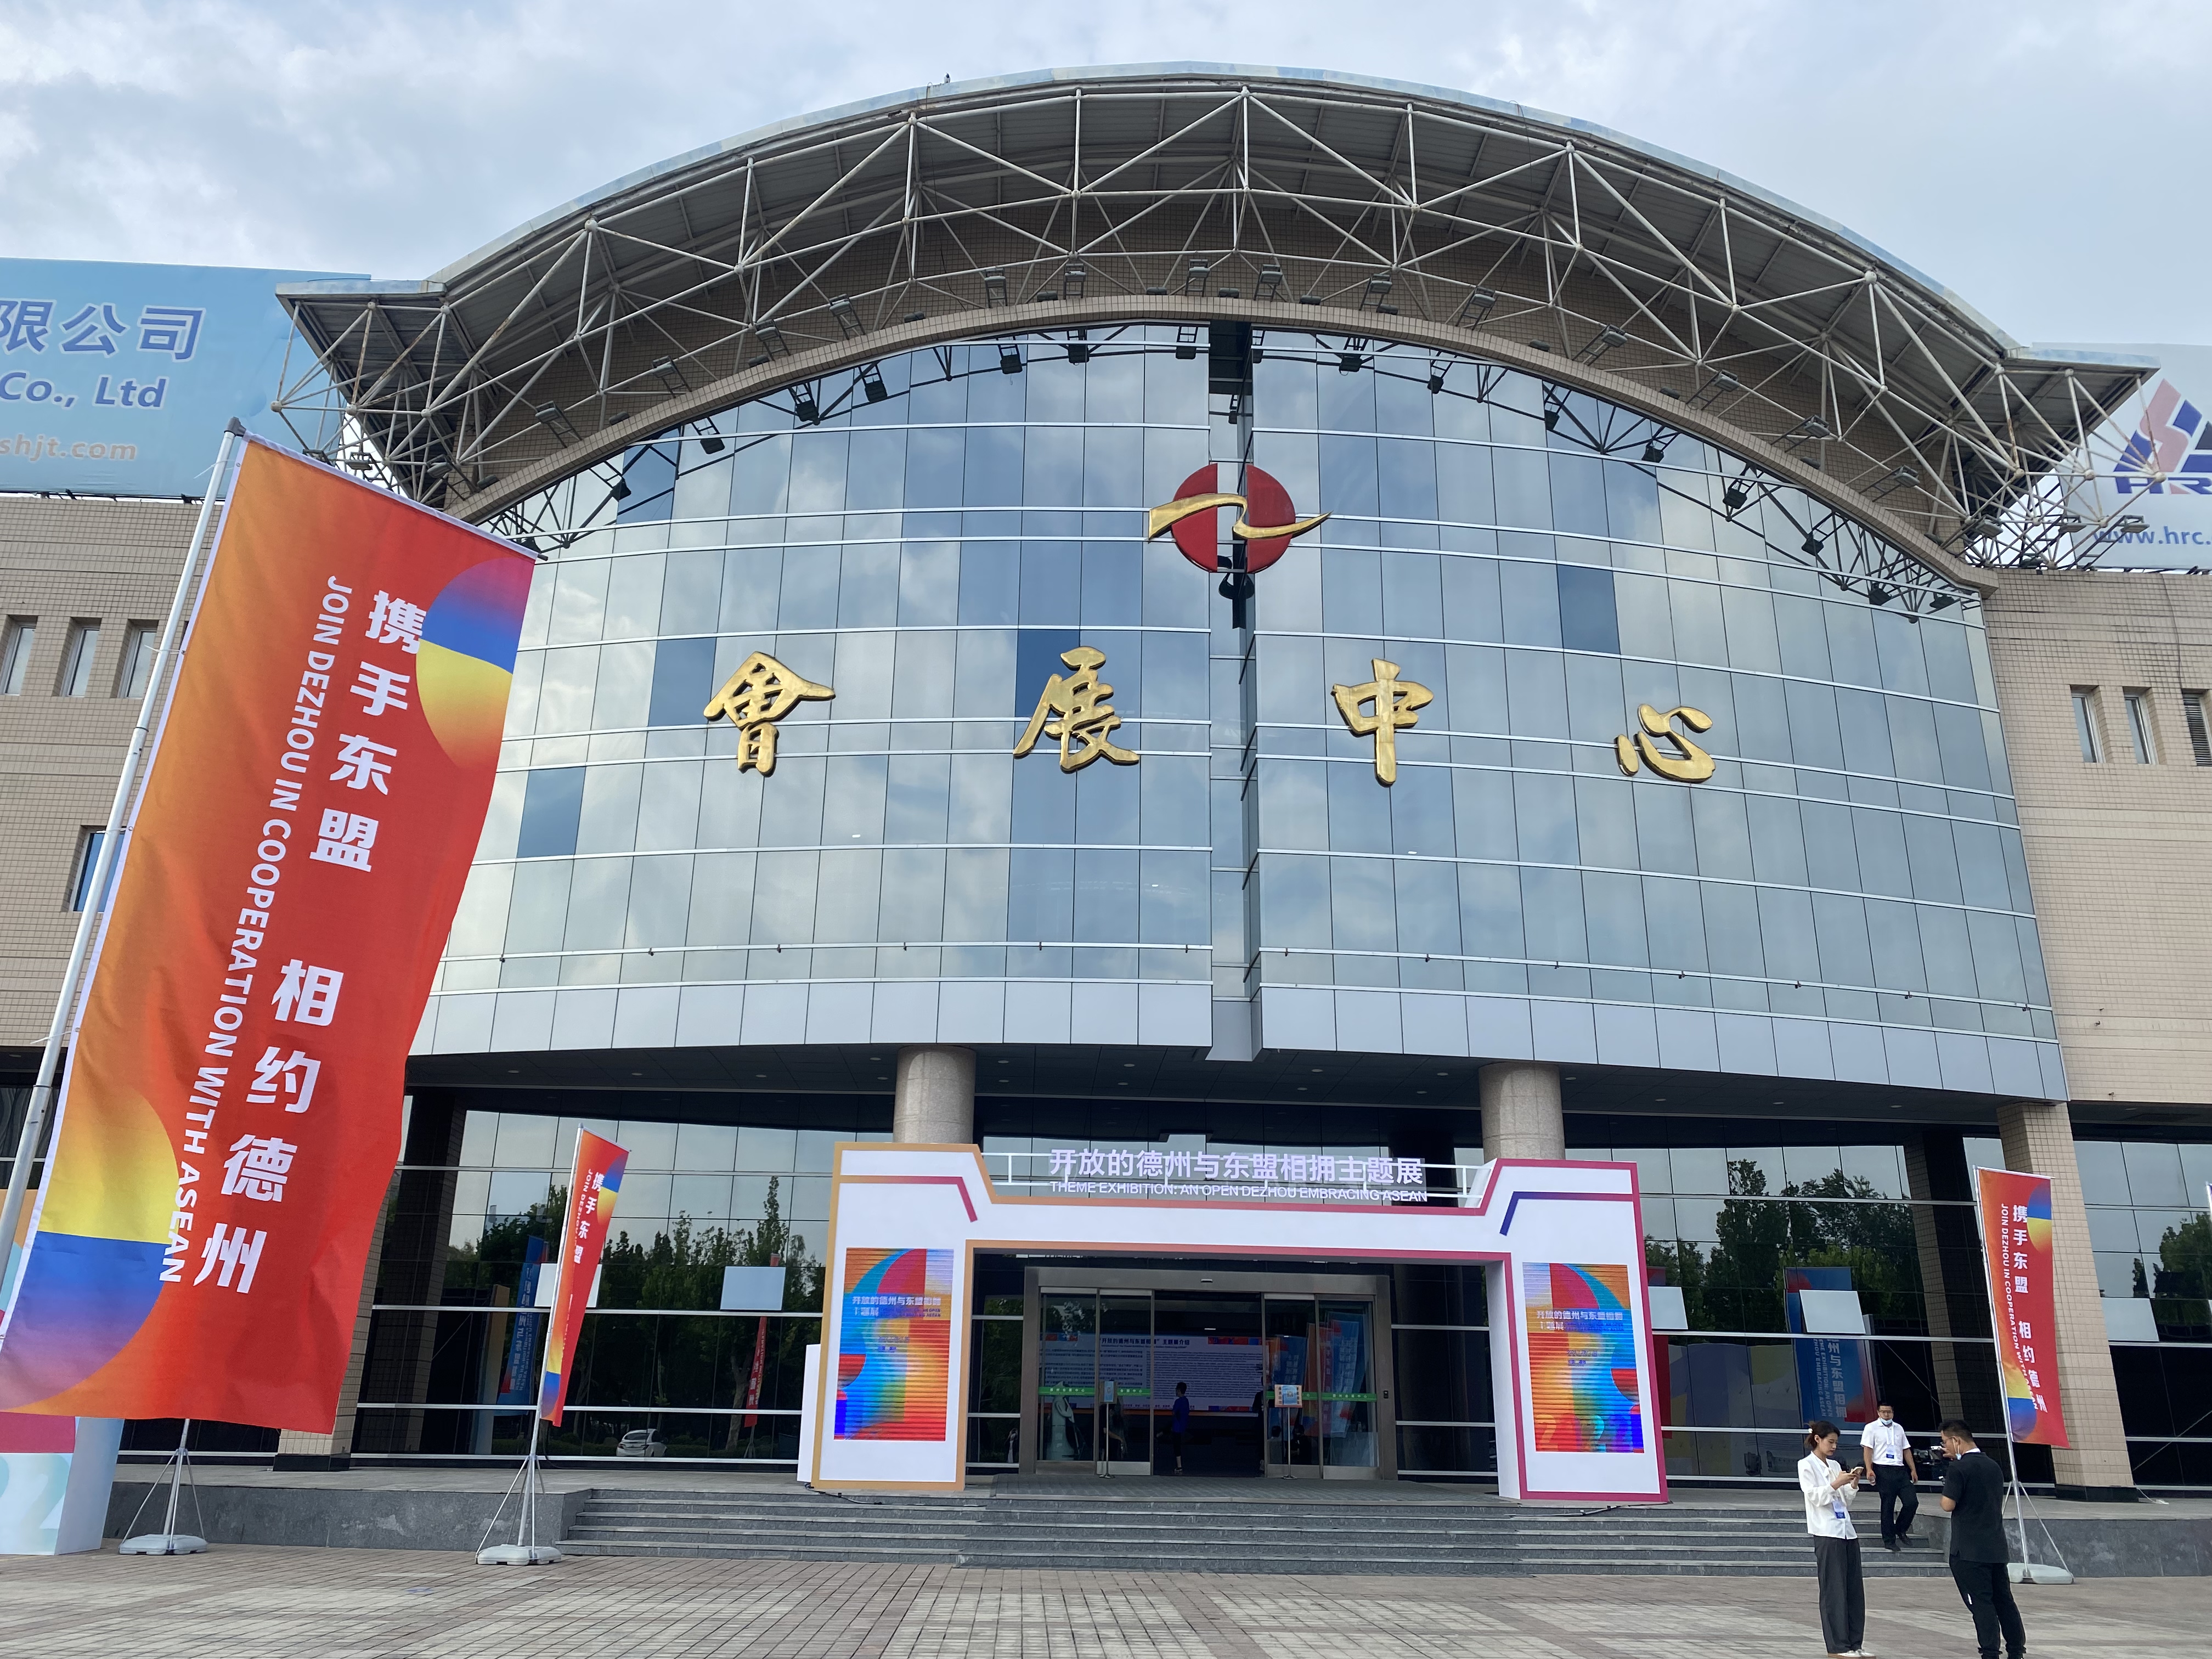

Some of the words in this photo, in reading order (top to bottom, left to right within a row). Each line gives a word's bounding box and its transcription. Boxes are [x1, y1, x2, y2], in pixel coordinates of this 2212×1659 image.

[0, 300, 205, 362] 限公司
[0, 371, 77, 408] Co.,
[94, 376, 168, 409] Ltd
[2093, 526, 2212, 545] www.hrc.
[313, 575, 353, 646] JOIN
[280, 650, 335, 774] DEZHOU
[310, 590, 426, 872] 携手东盟
[269, 778, 303, 811] IN
[205, 818, 292, 1057] COOPERATION
[183, 1066, 228, 1155] WITH
[193, 958, 343, 1294] 相约德州
[1049, 1148, 1424, 1184] 开放的德州与东盟相拥主题展
[1050, 1181, 1096, 1193] THEME
[1099, 1182, 1177, 1195] EXHIBITION:
[1180, 1184, 1200, 1195] AN
[1201, 1184, 1239, 1197] OPEN
[1242, 1185, 1296, 1198] DEZHOU
[1300, 1187, 1380, 1200] EMBRACING
[1382, 1189, 1427, 1202] ASEAN
[159, 1161, 200, 1283] ASEAN
[2001, 1227, 2010, 1267] DEZHOU
[2012, 1204, 2029, 1294] 携手东盟
[2004, 1268, 2010, 1279] IN
[2005, 1280, 2019, 1350] COOPERATION
[1827, 1339, 1848, 1418] 州与东盟相拥
